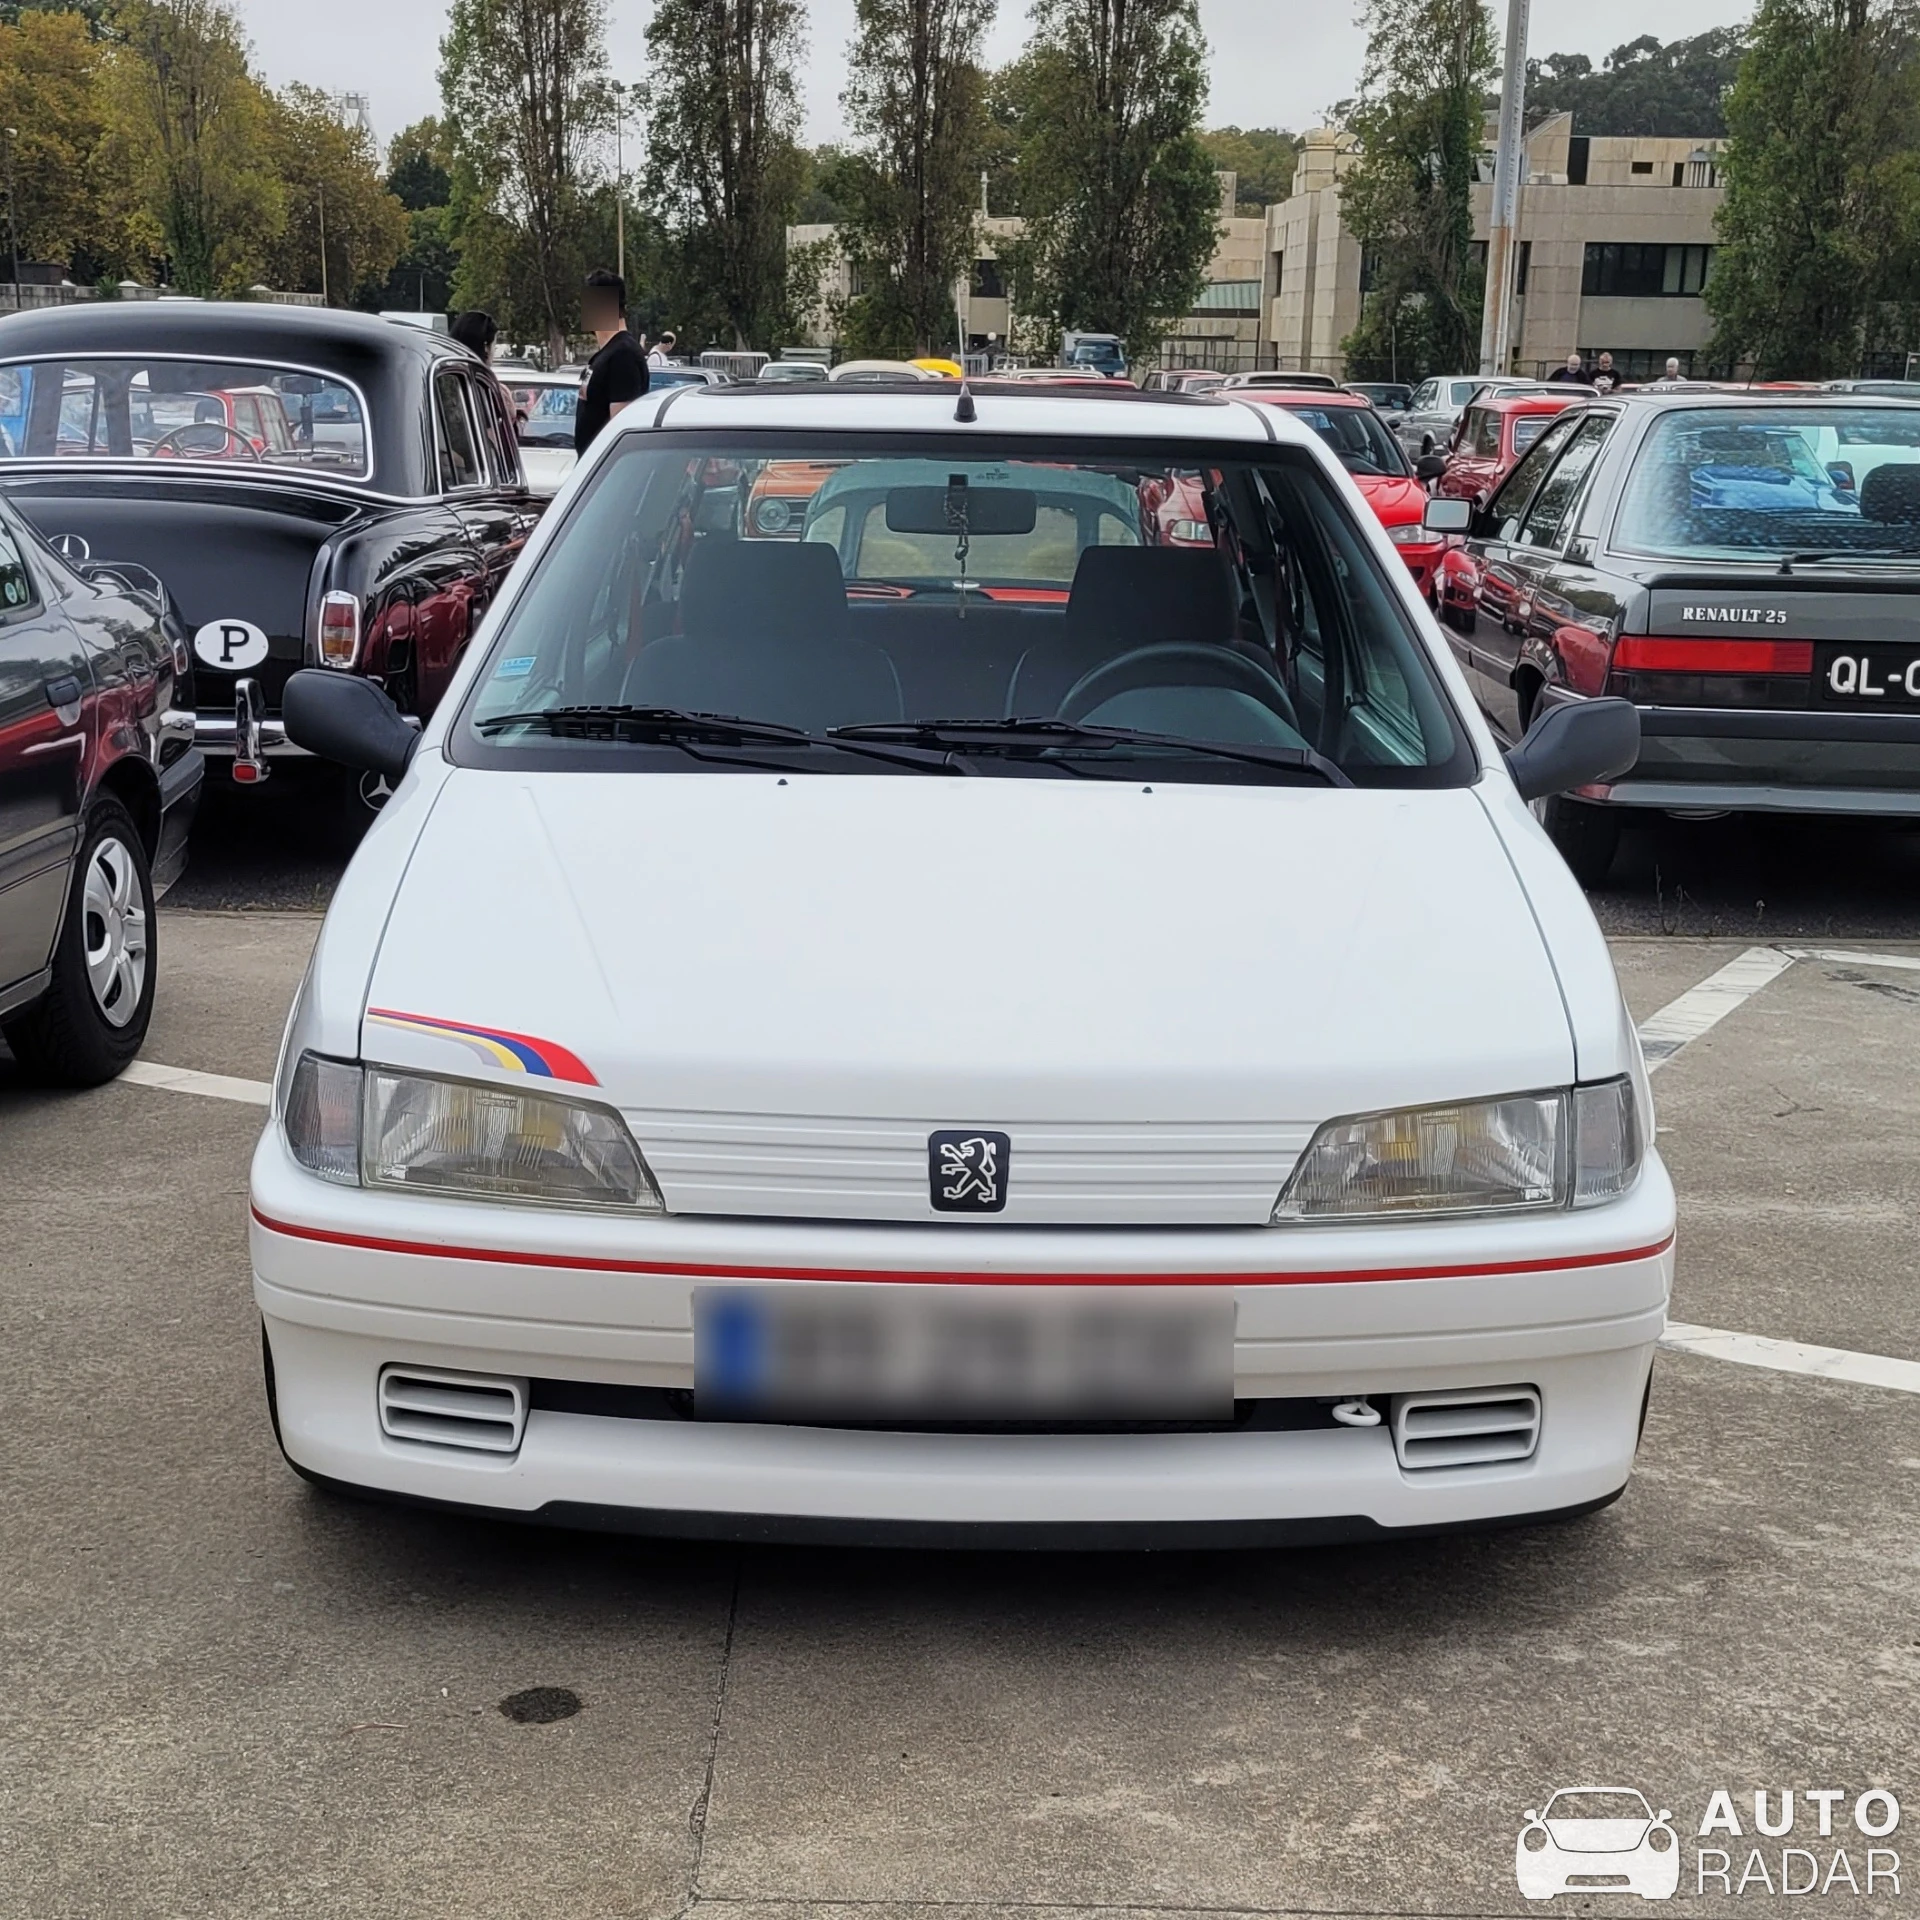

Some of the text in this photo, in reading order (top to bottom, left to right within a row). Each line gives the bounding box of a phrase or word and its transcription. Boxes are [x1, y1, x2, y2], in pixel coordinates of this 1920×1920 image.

[1682, 607, 1787, 624] RENAULT 25
[219, 625, 250, 662] P
